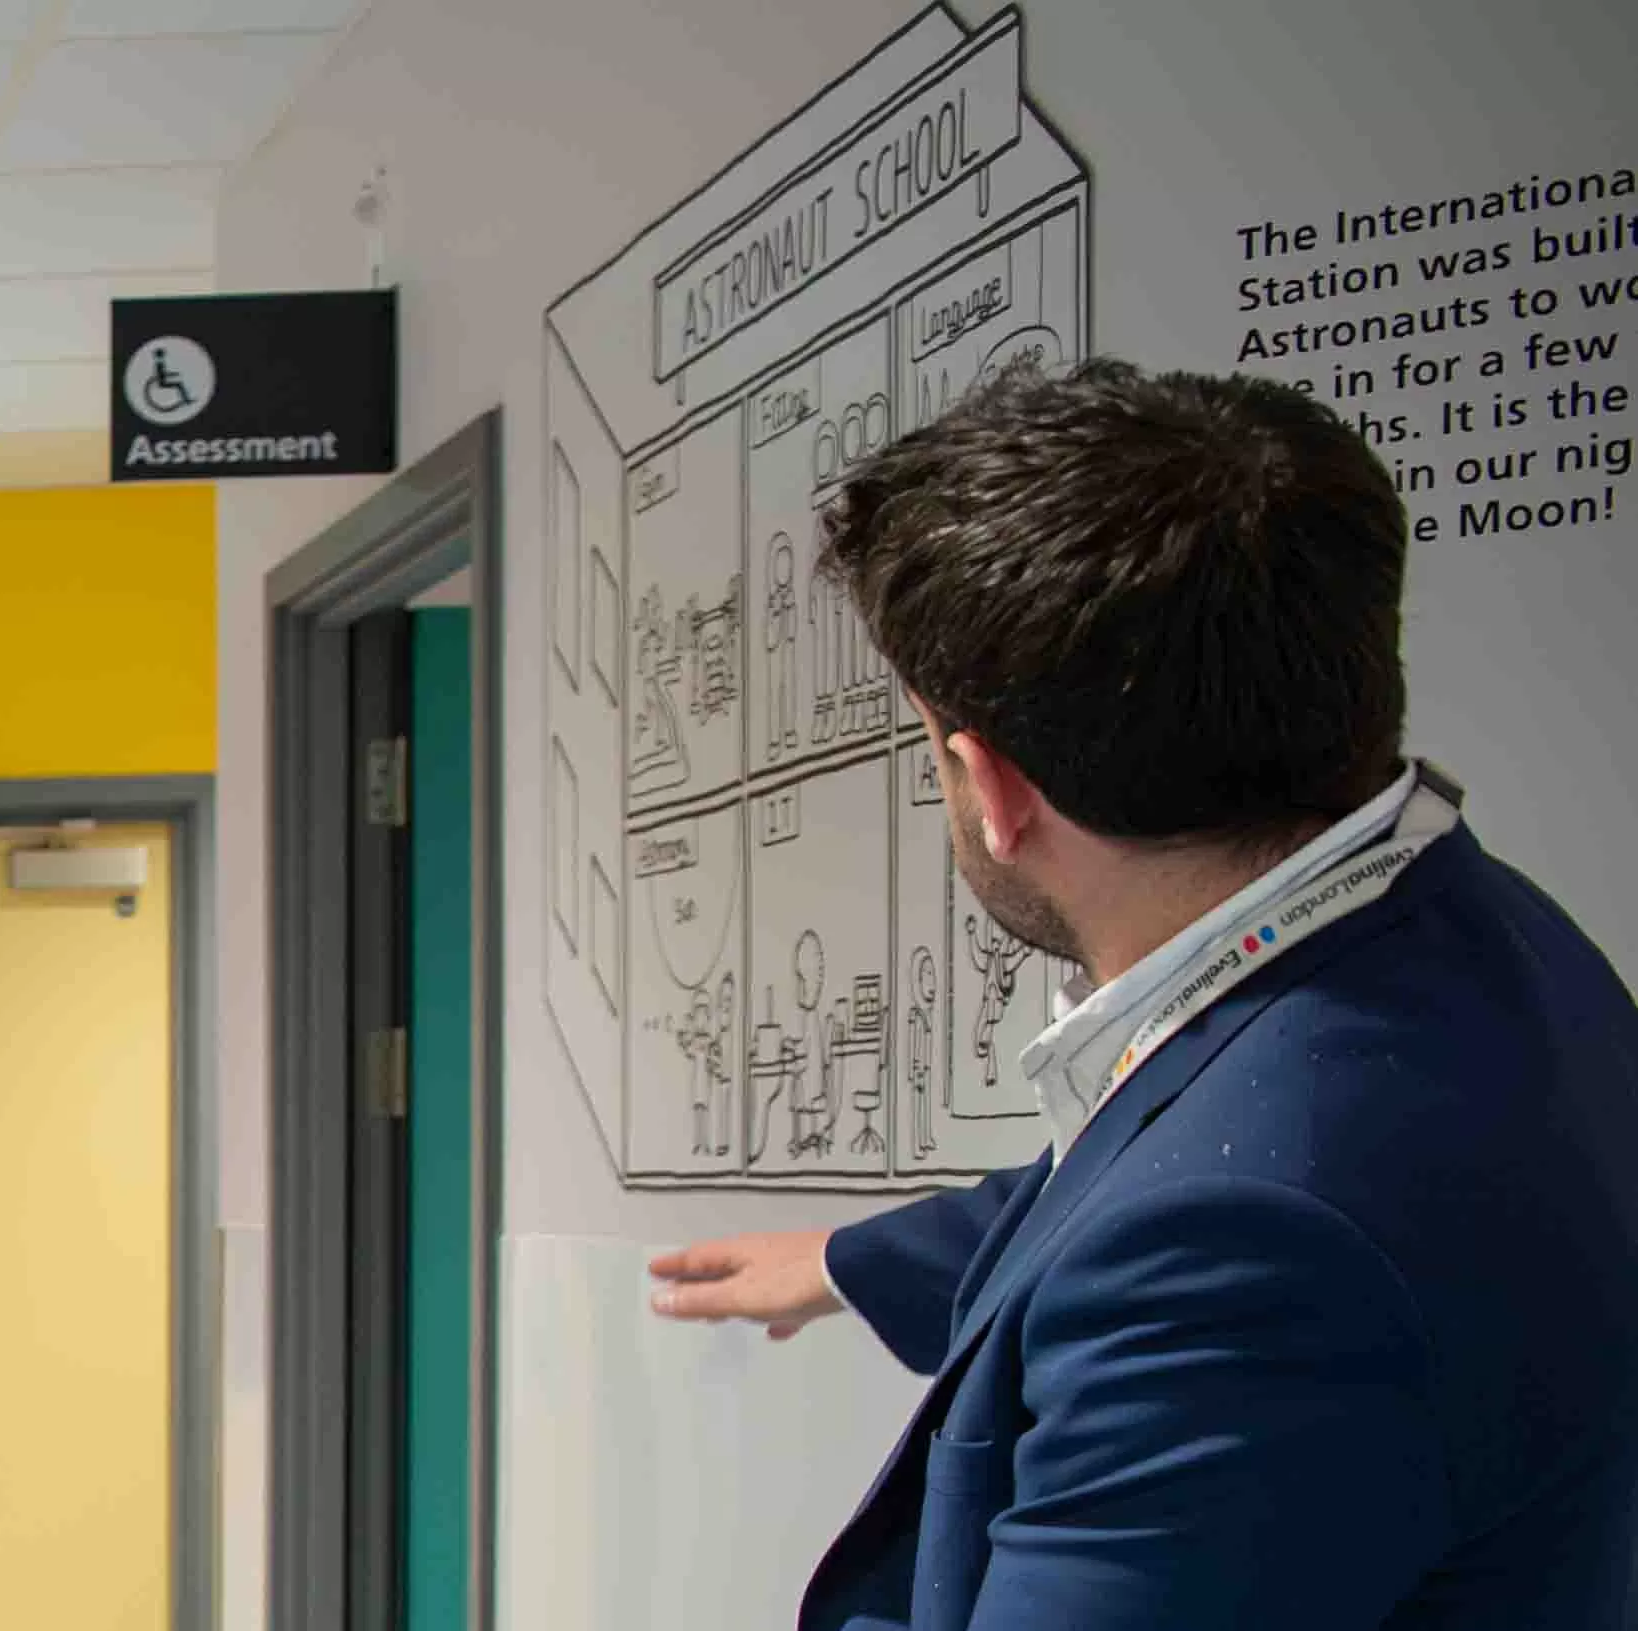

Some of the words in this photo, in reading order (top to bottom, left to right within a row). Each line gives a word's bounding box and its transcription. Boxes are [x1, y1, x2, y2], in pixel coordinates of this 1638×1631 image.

[684, 186, 833, 352] ASTRONAUT
[854, 88, 980, 238] SCHOOL
[1237, 222, 1317, 260] The
[1238, 261, 1399, 312] Station
[1418, 241, 1511, 281] was
[921, 276, 1004, 345] Language
[1237, 297, 1490, 363] Astronauts
[1510, 288, 1557, 320] to
[1334, 364, 1374, 399] in
[1392, 353, 1462, 390] for
[1480, 350, 1504, 377] a
[1524, 332, 1619, 370] few
[1443, 401, 1474, 435] It
[1493, 393, 1527, 428] is
[1547, 381, 1629, 420] the
[125, 431, 338, 465] Assessment
[1456, 449, 1538, 485] our
[1459, 486, 1614, 537] Moon!
